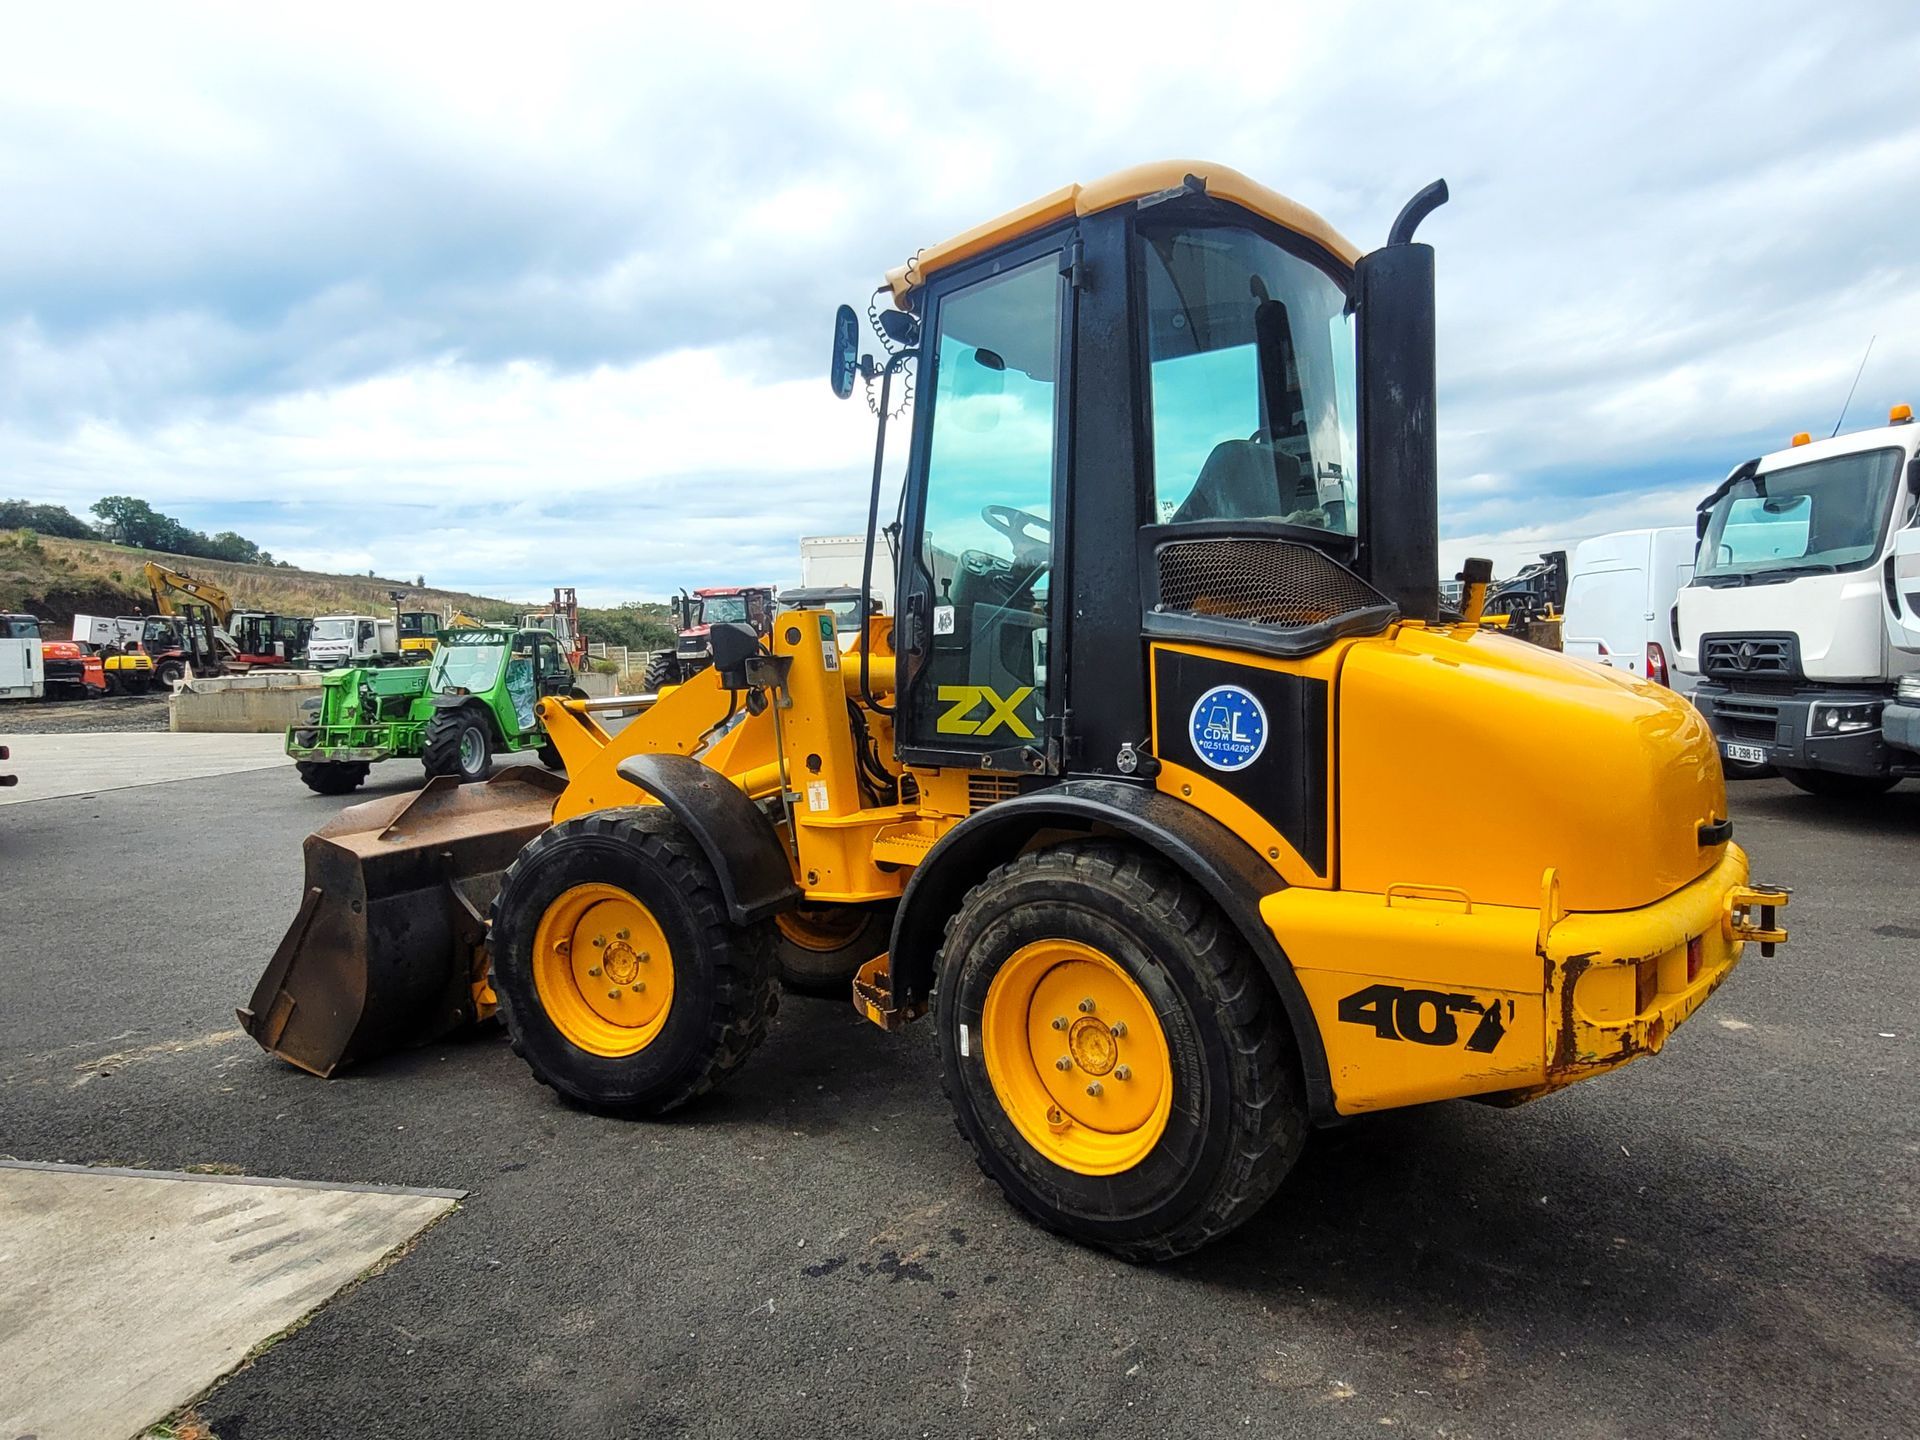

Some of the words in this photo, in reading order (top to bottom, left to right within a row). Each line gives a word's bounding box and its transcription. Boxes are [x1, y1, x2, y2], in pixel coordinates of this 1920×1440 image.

[937, 685, 1036, 739] ZX
[1203, 728, 1229, 741] CDM
[1203, 741, 1250, 753] 02.51.13.42.06
